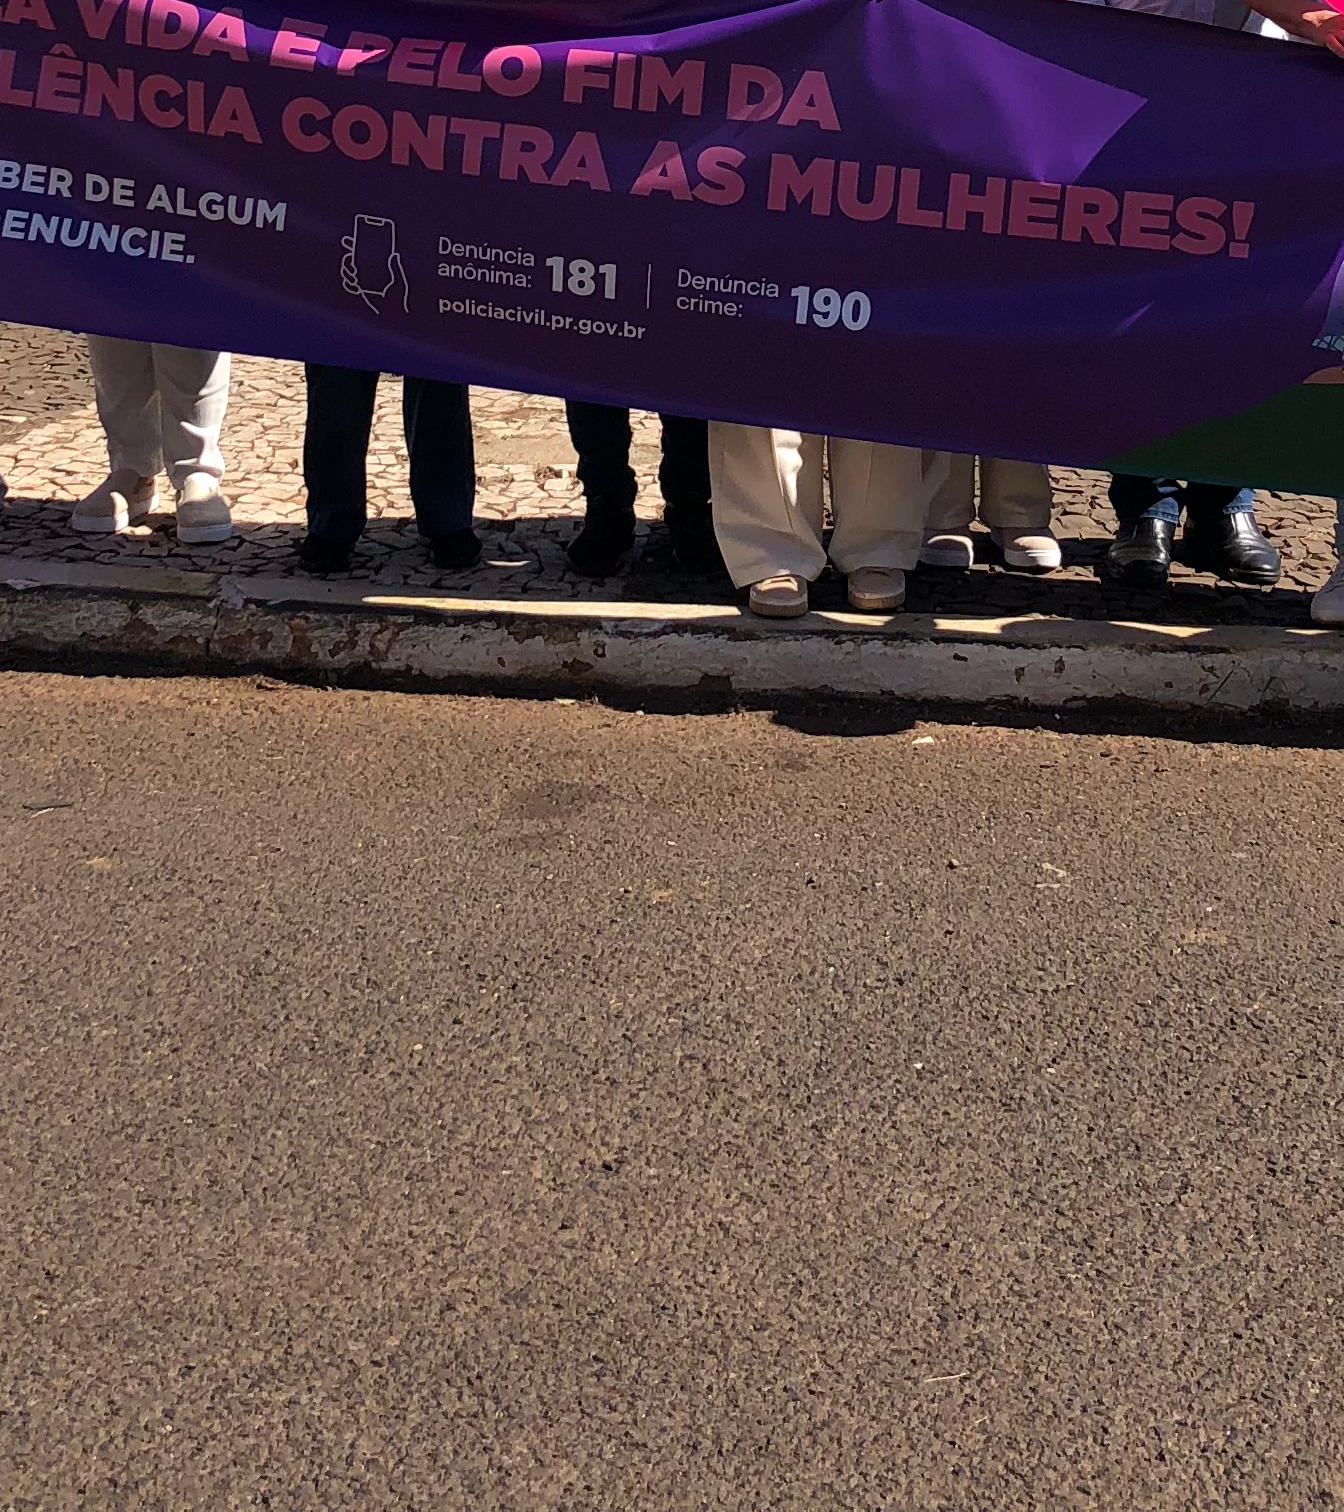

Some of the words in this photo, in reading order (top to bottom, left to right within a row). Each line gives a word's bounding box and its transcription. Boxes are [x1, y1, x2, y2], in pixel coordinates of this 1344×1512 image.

[269, 17, 328, 72] E
[337, 31, 542, 98] PELO
[562, 44, 706, 118] FIM
[726, 62, 842, 134] DA
[84, 172, 134, 208] DE
[145, 183, 288, 232] ALGUM
[280, 95, 612, 194] CONTRA
[630, 140, 747, 208] AS
[766, 154, 1256, 259] MULHERES!
[437, 236, 536, 268] Denúncia
[545, 255, 618, 300] 181
[437, 261, 533, 289] anônima:
[438, 295, 646, 340] policiacivil.pr.gov.br
[675, 293, 744, 318] crime:
[676, 268, 780, 298] Denúncia
[790, 285, 872, 332] 190
